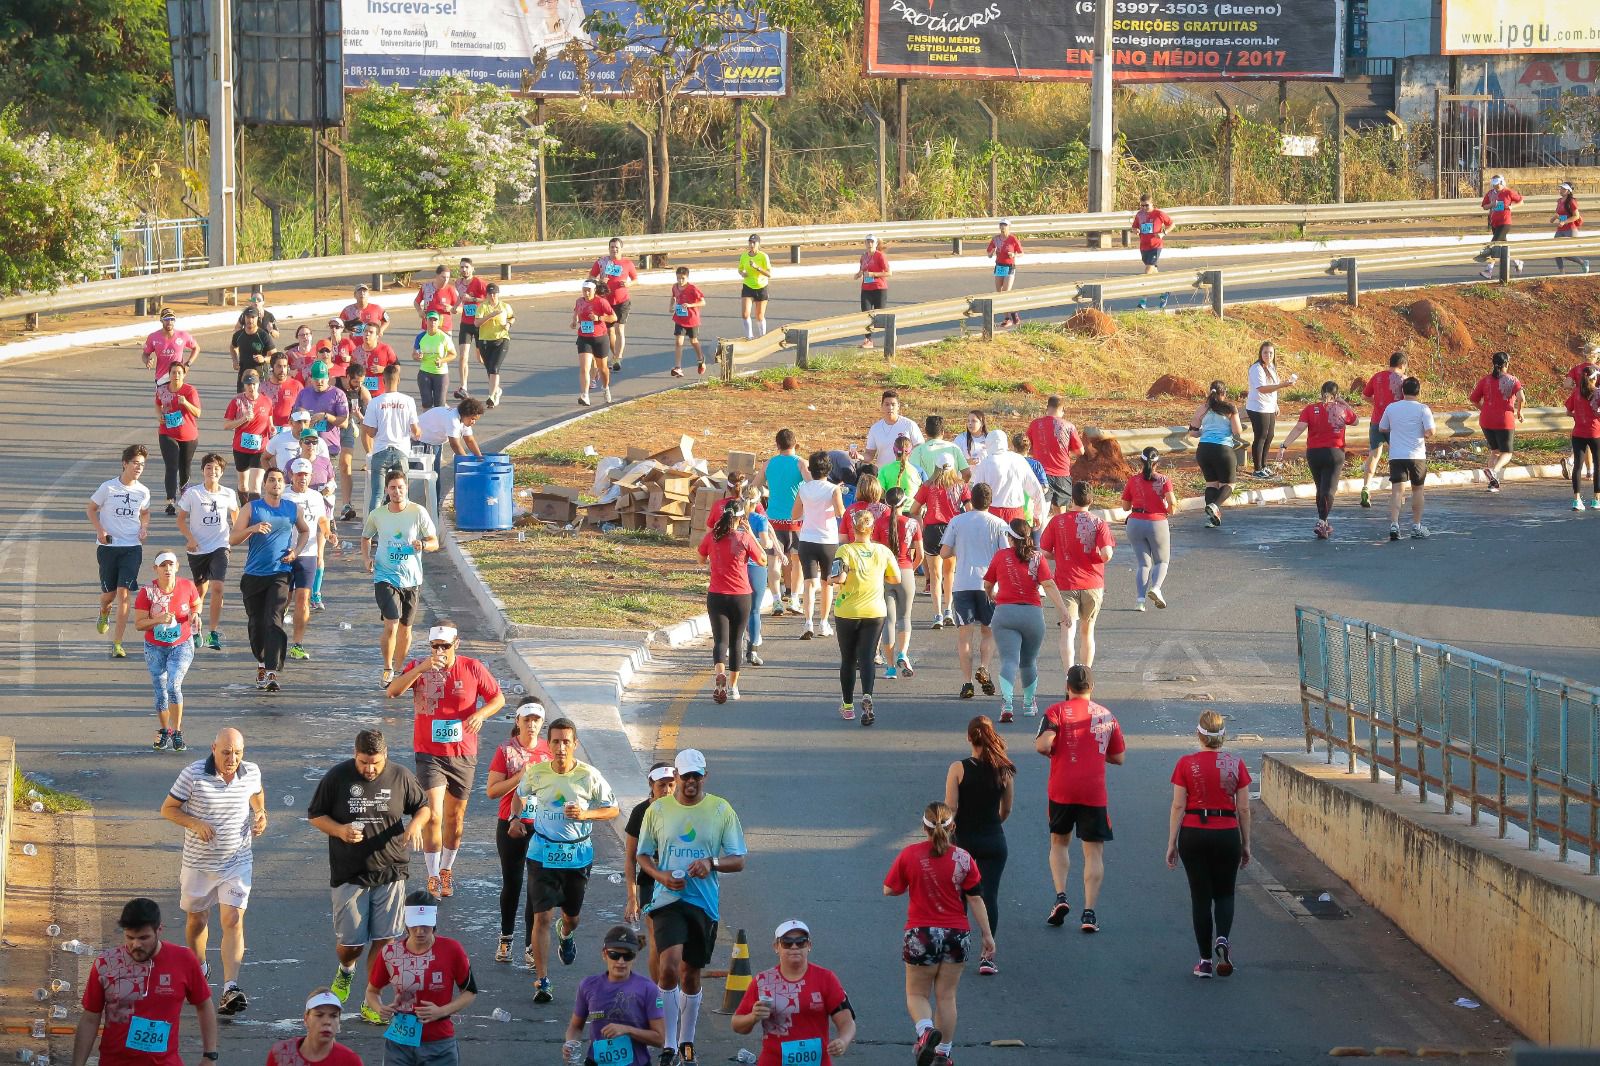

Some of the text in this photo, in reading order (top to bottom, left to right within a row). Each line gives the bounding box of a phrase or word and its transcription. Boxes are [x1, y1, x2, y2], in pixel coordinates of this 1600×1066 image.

[367, 0, 456, 15] Inscreva-se!
[1116, 2, 1208, 14] 3997-3503
[1214, 3, 1282, 17] (Bueno)
[889, 0, 1001, 32] PROTÁGORAS
[1112, 19, 1258, 34] SCRIÇÕES GRATUITAS
[450, 29, 476, 39] Ranking
[907, 34, 981, 45] ENSINO MÉDIO
[906, 43, 981, 54] VESTIBULARES
[929, 53, 958, 62] ENEM
[1066, 48, 1147, 66] ENINO
[1152, 48, 1220, 66] MÉDIO
[1237, 50, 1287, 66] 2017
[381, 66, 394, 76] km
[396, 67, 409, 76] 503
[725, 66, 781, 79] UNIP
[390, 552, 410, 562] 5020
[157, 630, 178, 639] 5334
[435, 726, 459, 738] 5308
[350, 806, 367, 814] 2011
[547, 852, 573, 862] 5229
[668, 845, 706, 859] Furnas
[133, 1030, 164, 1044] 5284
[392, 1023, 416, 1038] 5459
[599, 1047, 628, 1064] 5039
[787, 1050, 817, 1064] 5080
